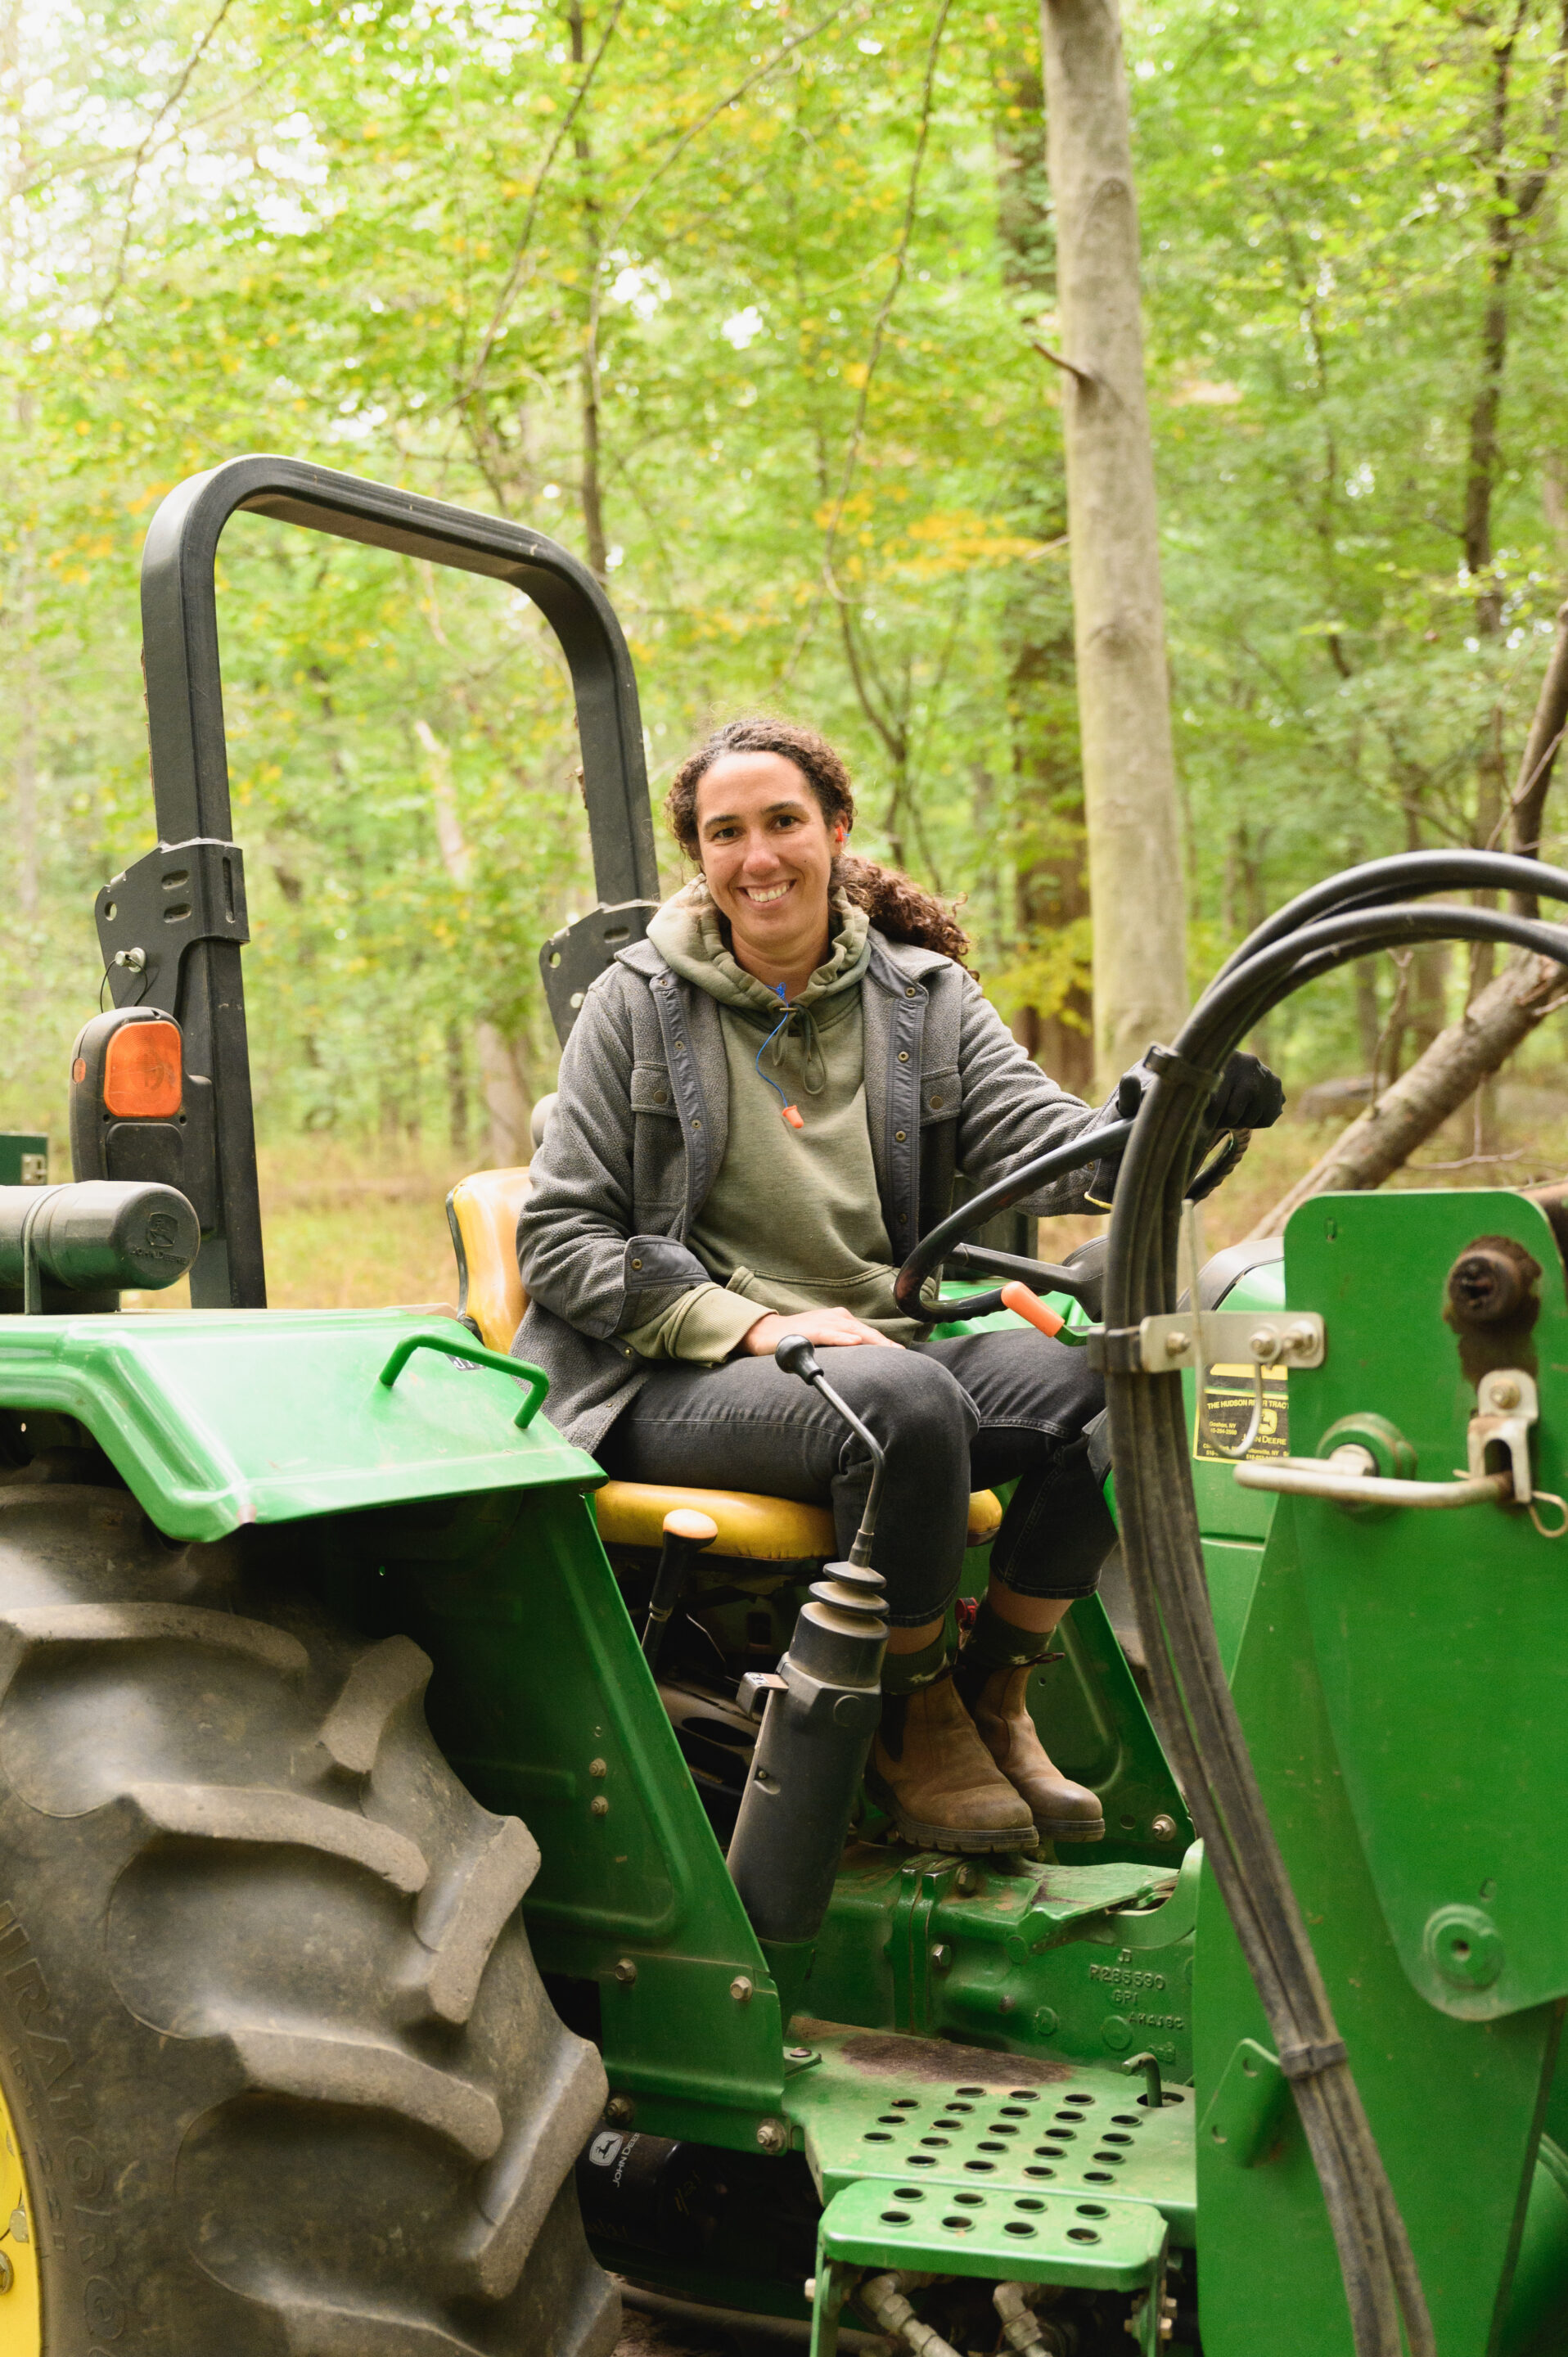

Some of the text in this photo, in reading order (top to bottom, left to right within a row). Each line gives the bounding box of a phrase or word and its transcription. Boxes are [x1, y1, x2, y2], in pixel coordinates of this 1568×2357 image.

[155, 1251, 189, 1265] DEERE
[1207, 1401, 1220, 1409] THE
[1220, 1399, 1248, 1408] HUDSON
[1262, 1435, 1286, 1445] DEERE
[612, 2132, 640, 2188] JOHN DEER
